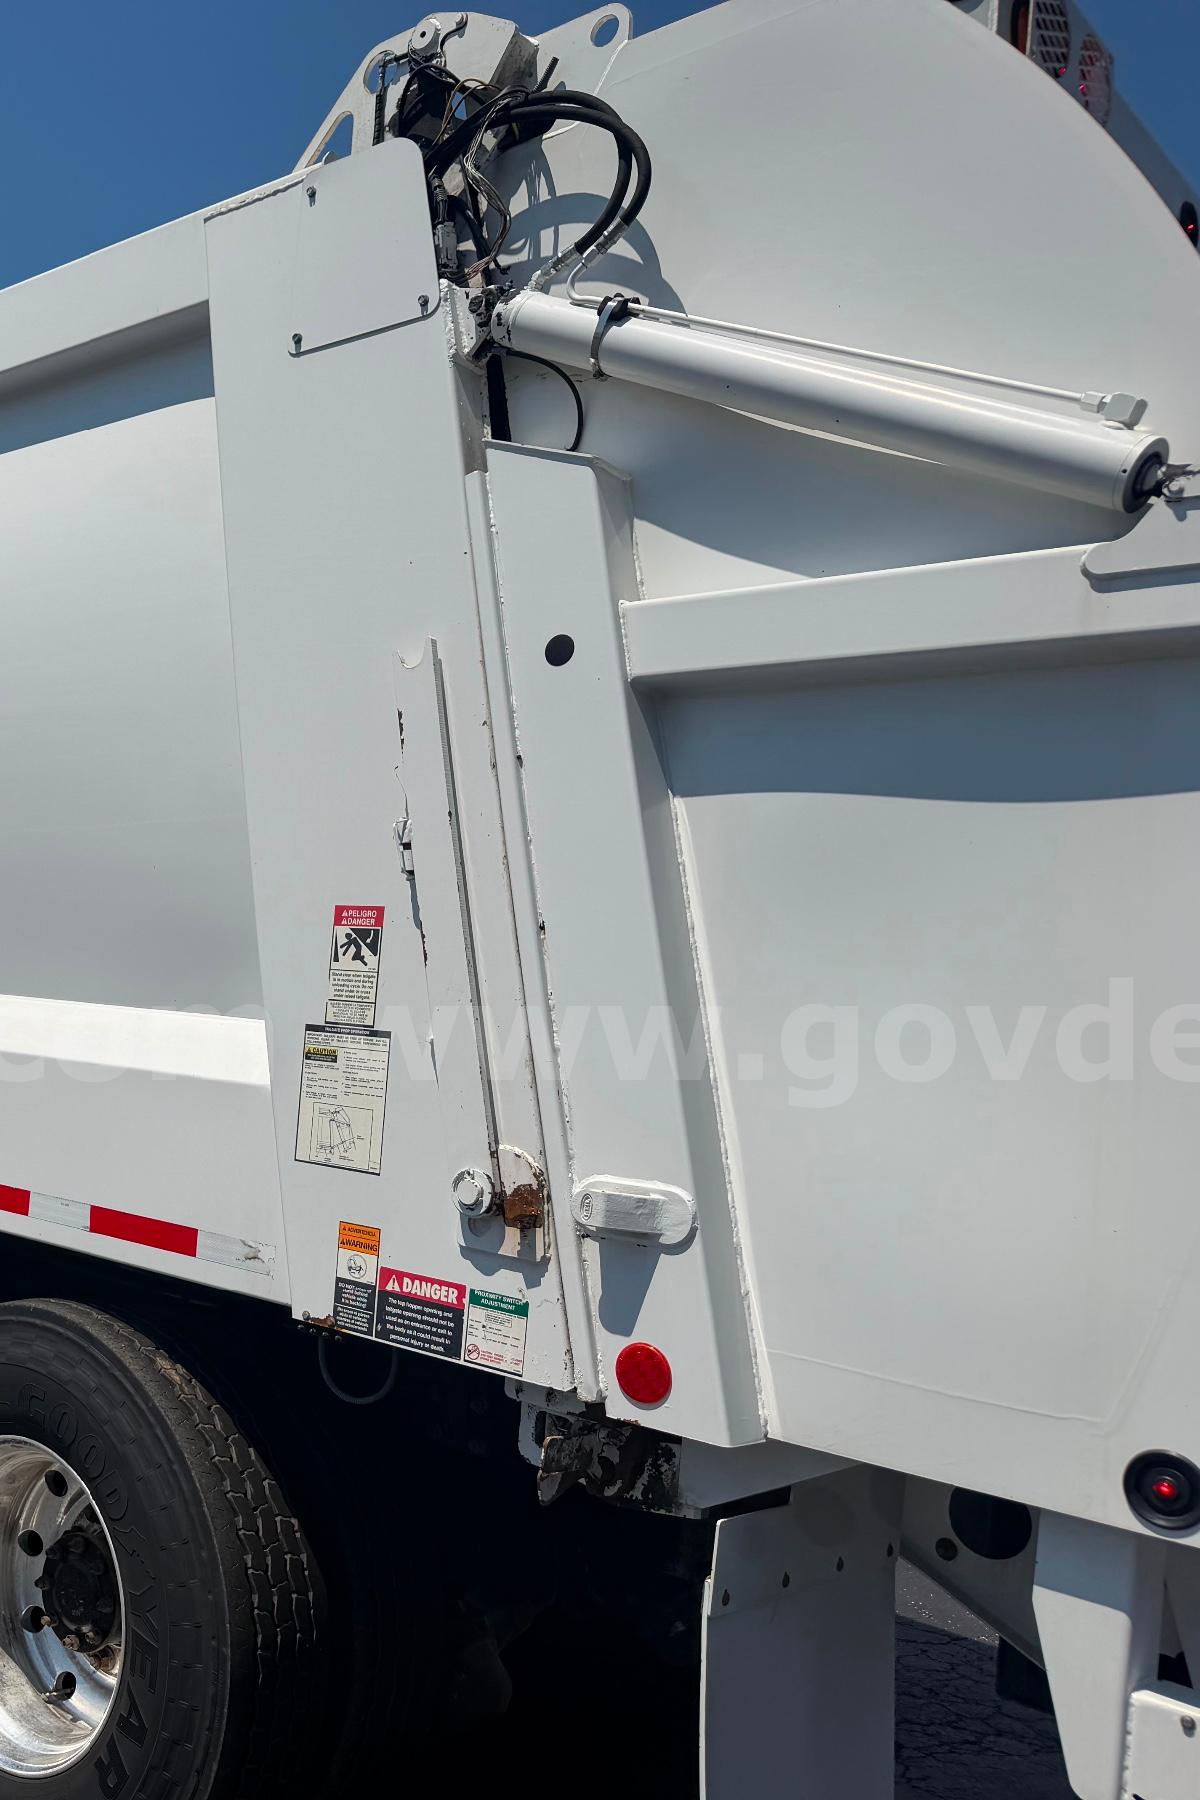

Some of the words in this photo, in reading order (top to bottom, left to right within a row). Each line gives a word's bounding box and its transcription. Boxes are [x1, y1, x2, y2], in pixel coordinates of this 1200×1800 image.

[346, 1239, 378, 1252] WARNING
[402, 1277, 458, 1304] DANGER
[406, 1301, 422, 1310] hopper
[481, 1299, 516, 1310] ADJUSTMENT
[386, 1306, 402, 1314] tailgate
[403, 1310, 421, 1320] opening
[422, 1314, 438, 1324] should
[394, 1325, 406, 1334] body
[411, 1321, 431, 1330] entrance
[390, 1334, 409, 1343] personal
[410, 1338, 424, 1347] injury
[19, 1382, 160, 1800] GOODYEAR
